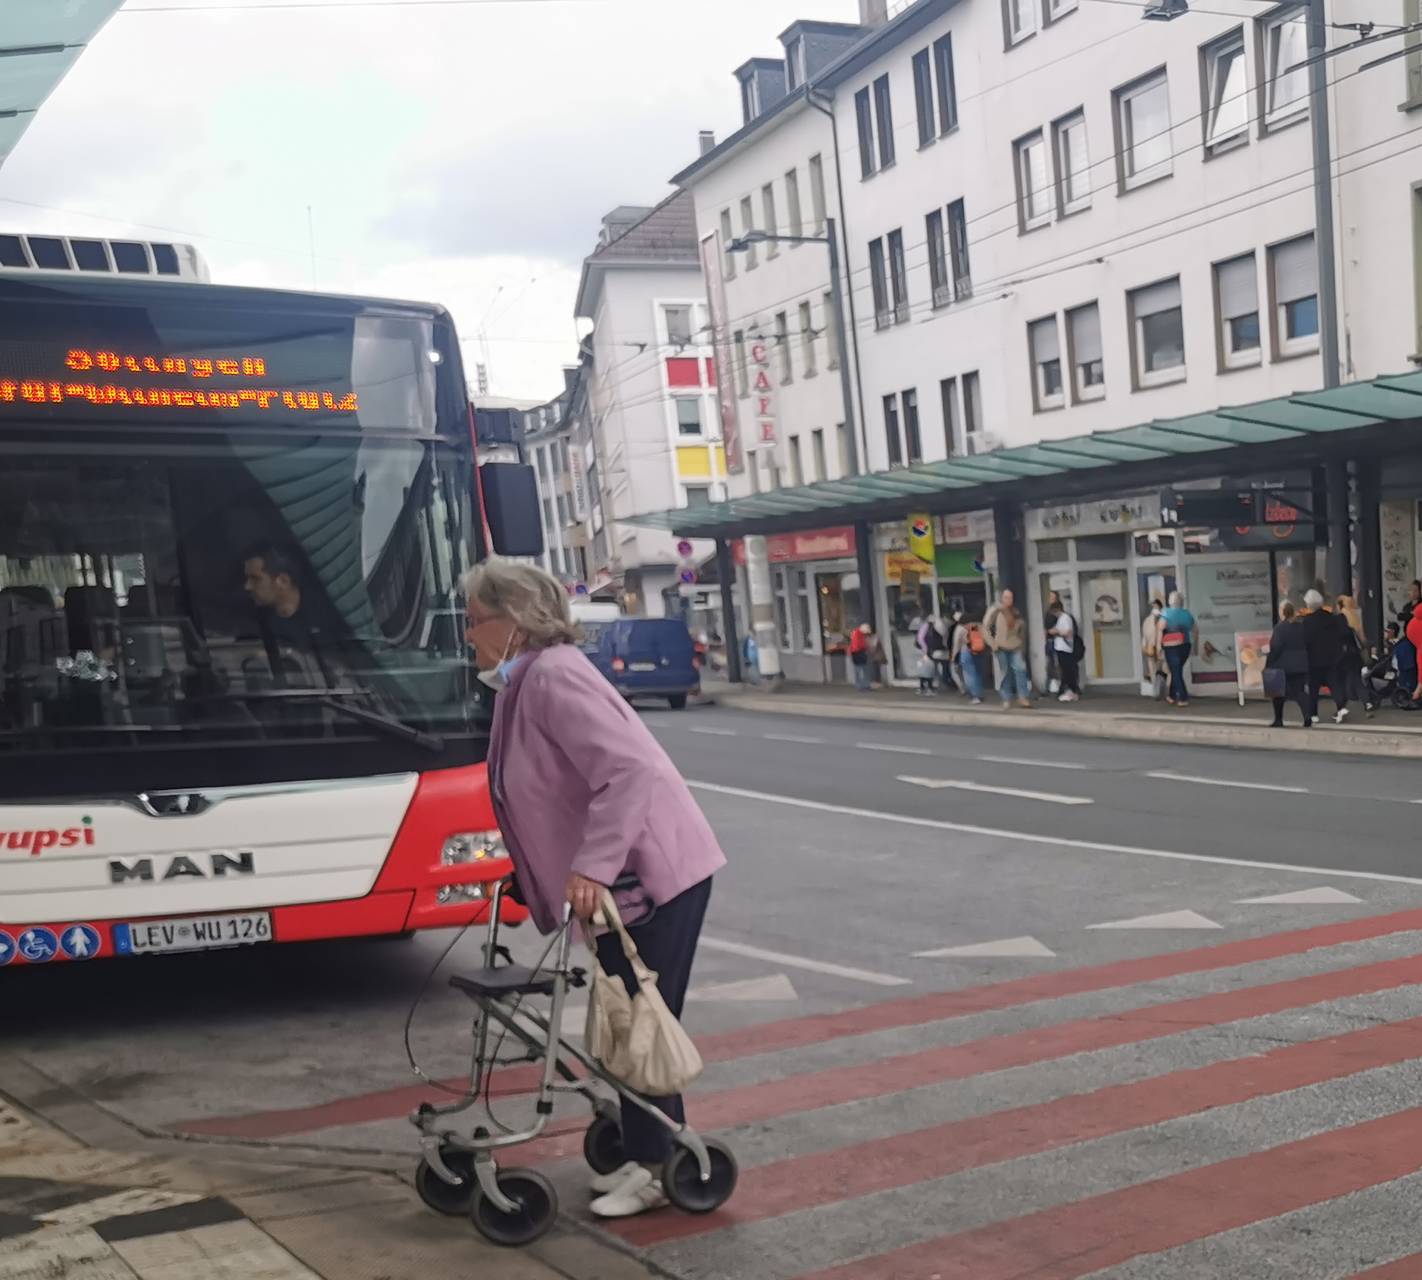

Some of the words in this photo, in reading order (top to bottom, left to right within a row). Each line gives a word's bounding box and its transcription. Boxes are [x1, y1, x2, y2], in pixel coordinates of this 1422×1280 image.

[109, 852, 255, 884] MAN
[132, 925, 175, 948] LEV
[193, 920, 222, 942] WU
[227, 917, 269, 939] 126
